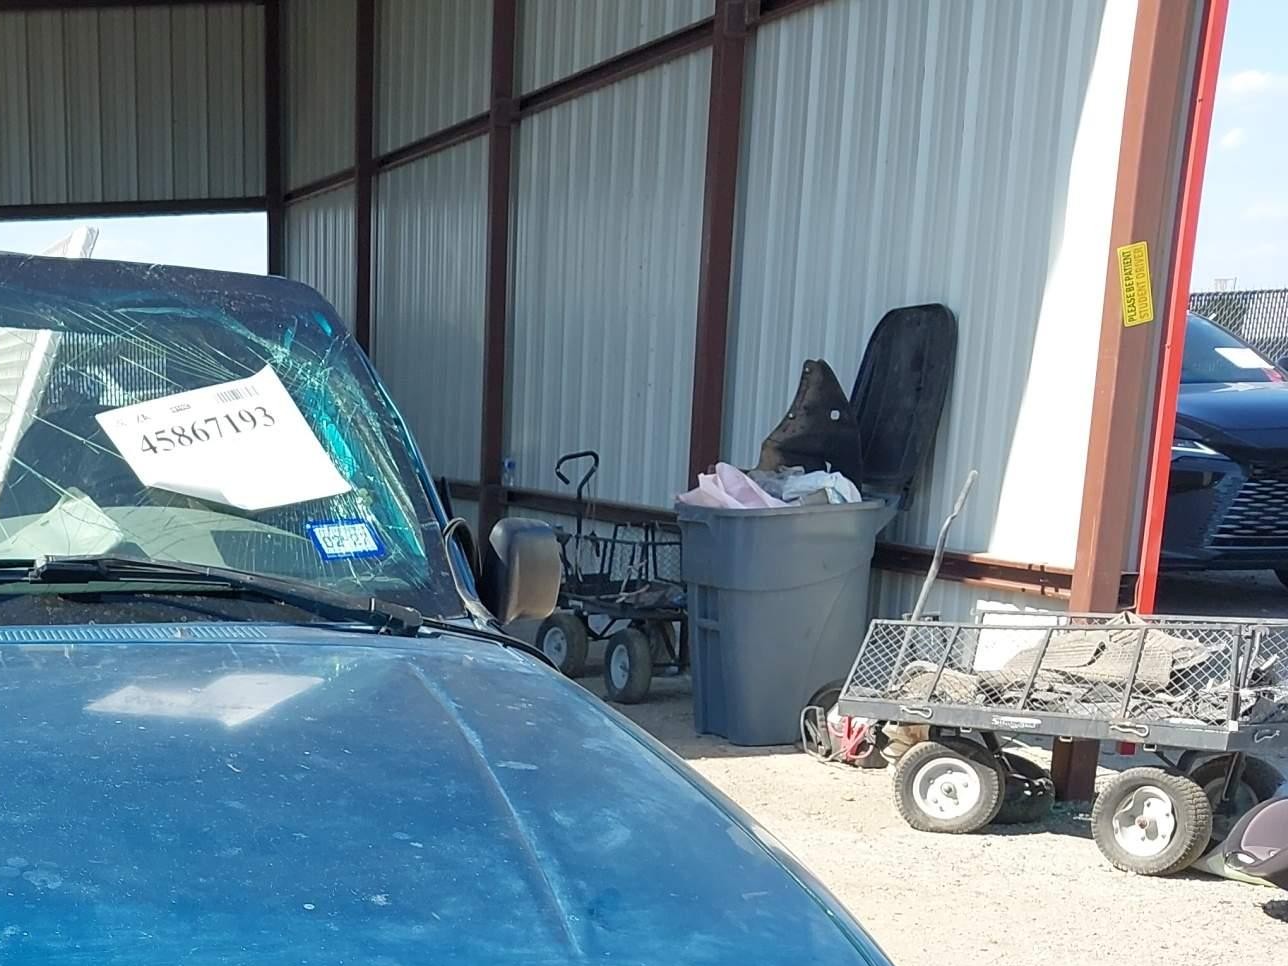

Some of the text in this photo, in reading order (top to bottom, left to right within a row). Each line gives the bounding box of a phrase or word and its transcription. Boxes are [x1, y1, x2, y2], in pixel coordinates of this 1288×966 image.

[1122, 251, 1136, 322] PLEASE BE PATIENT
[1134, 248, 1149, 319] STUDENT DRIVER
[141, 406, 275, 454] 45867193
